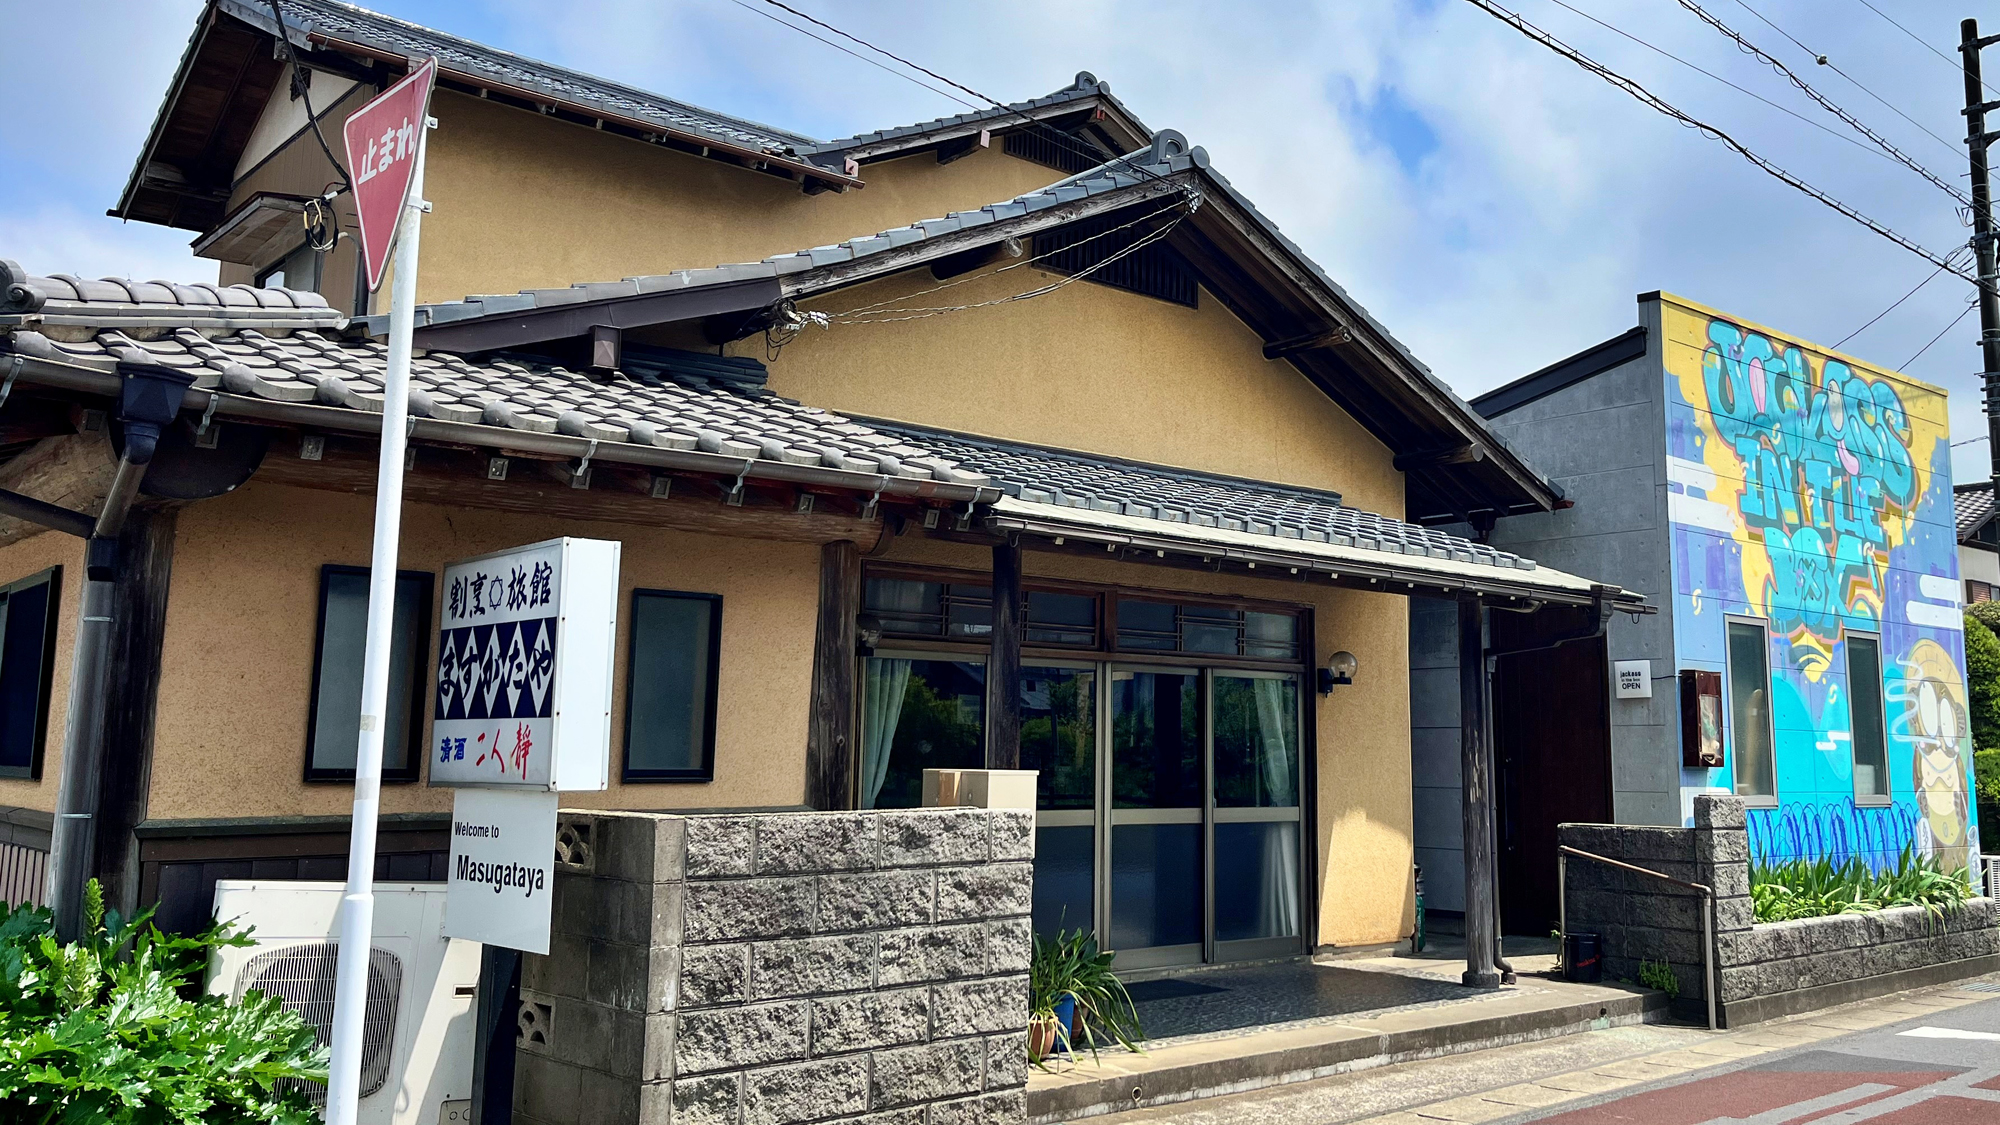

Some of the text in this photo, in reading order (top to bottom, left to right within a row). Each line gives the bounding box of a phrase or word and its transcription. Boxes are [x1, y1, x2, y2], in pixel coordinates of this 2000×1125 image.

[358, 116, 415, 185] 止まれ
[439, 638, 554, 700] ますがたや
[440, 736, 467, 763] 清酒
[455, 821, 500, 838] Welcome to
[456, 854, 545, 898] Masugataya
